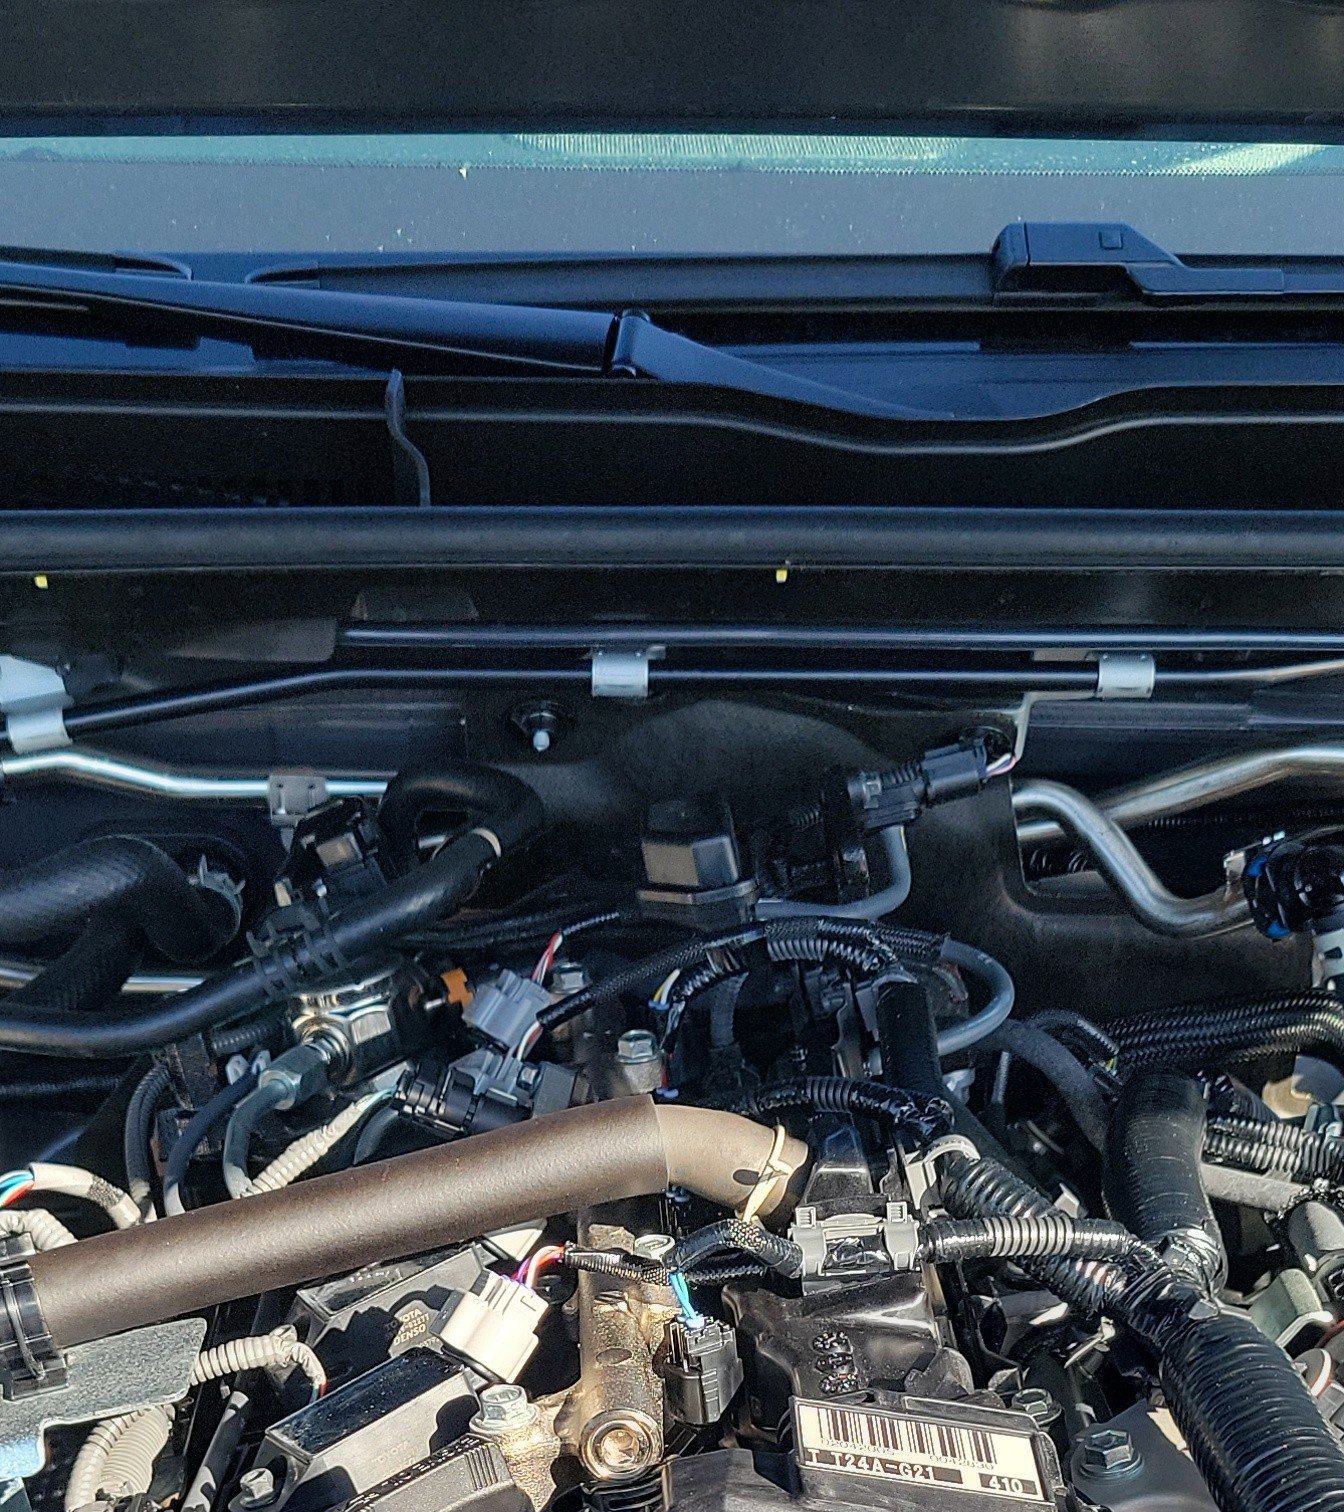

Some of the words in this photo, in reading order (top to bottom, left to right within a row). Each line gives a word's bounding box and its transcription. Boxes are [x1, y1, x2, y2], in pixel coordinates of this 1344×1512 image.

[393, 1323, 426, 1346] DENSO
[831, 1452, 936, 1481] T24A-G21
[987, 1477, 1024, 1494] 410
